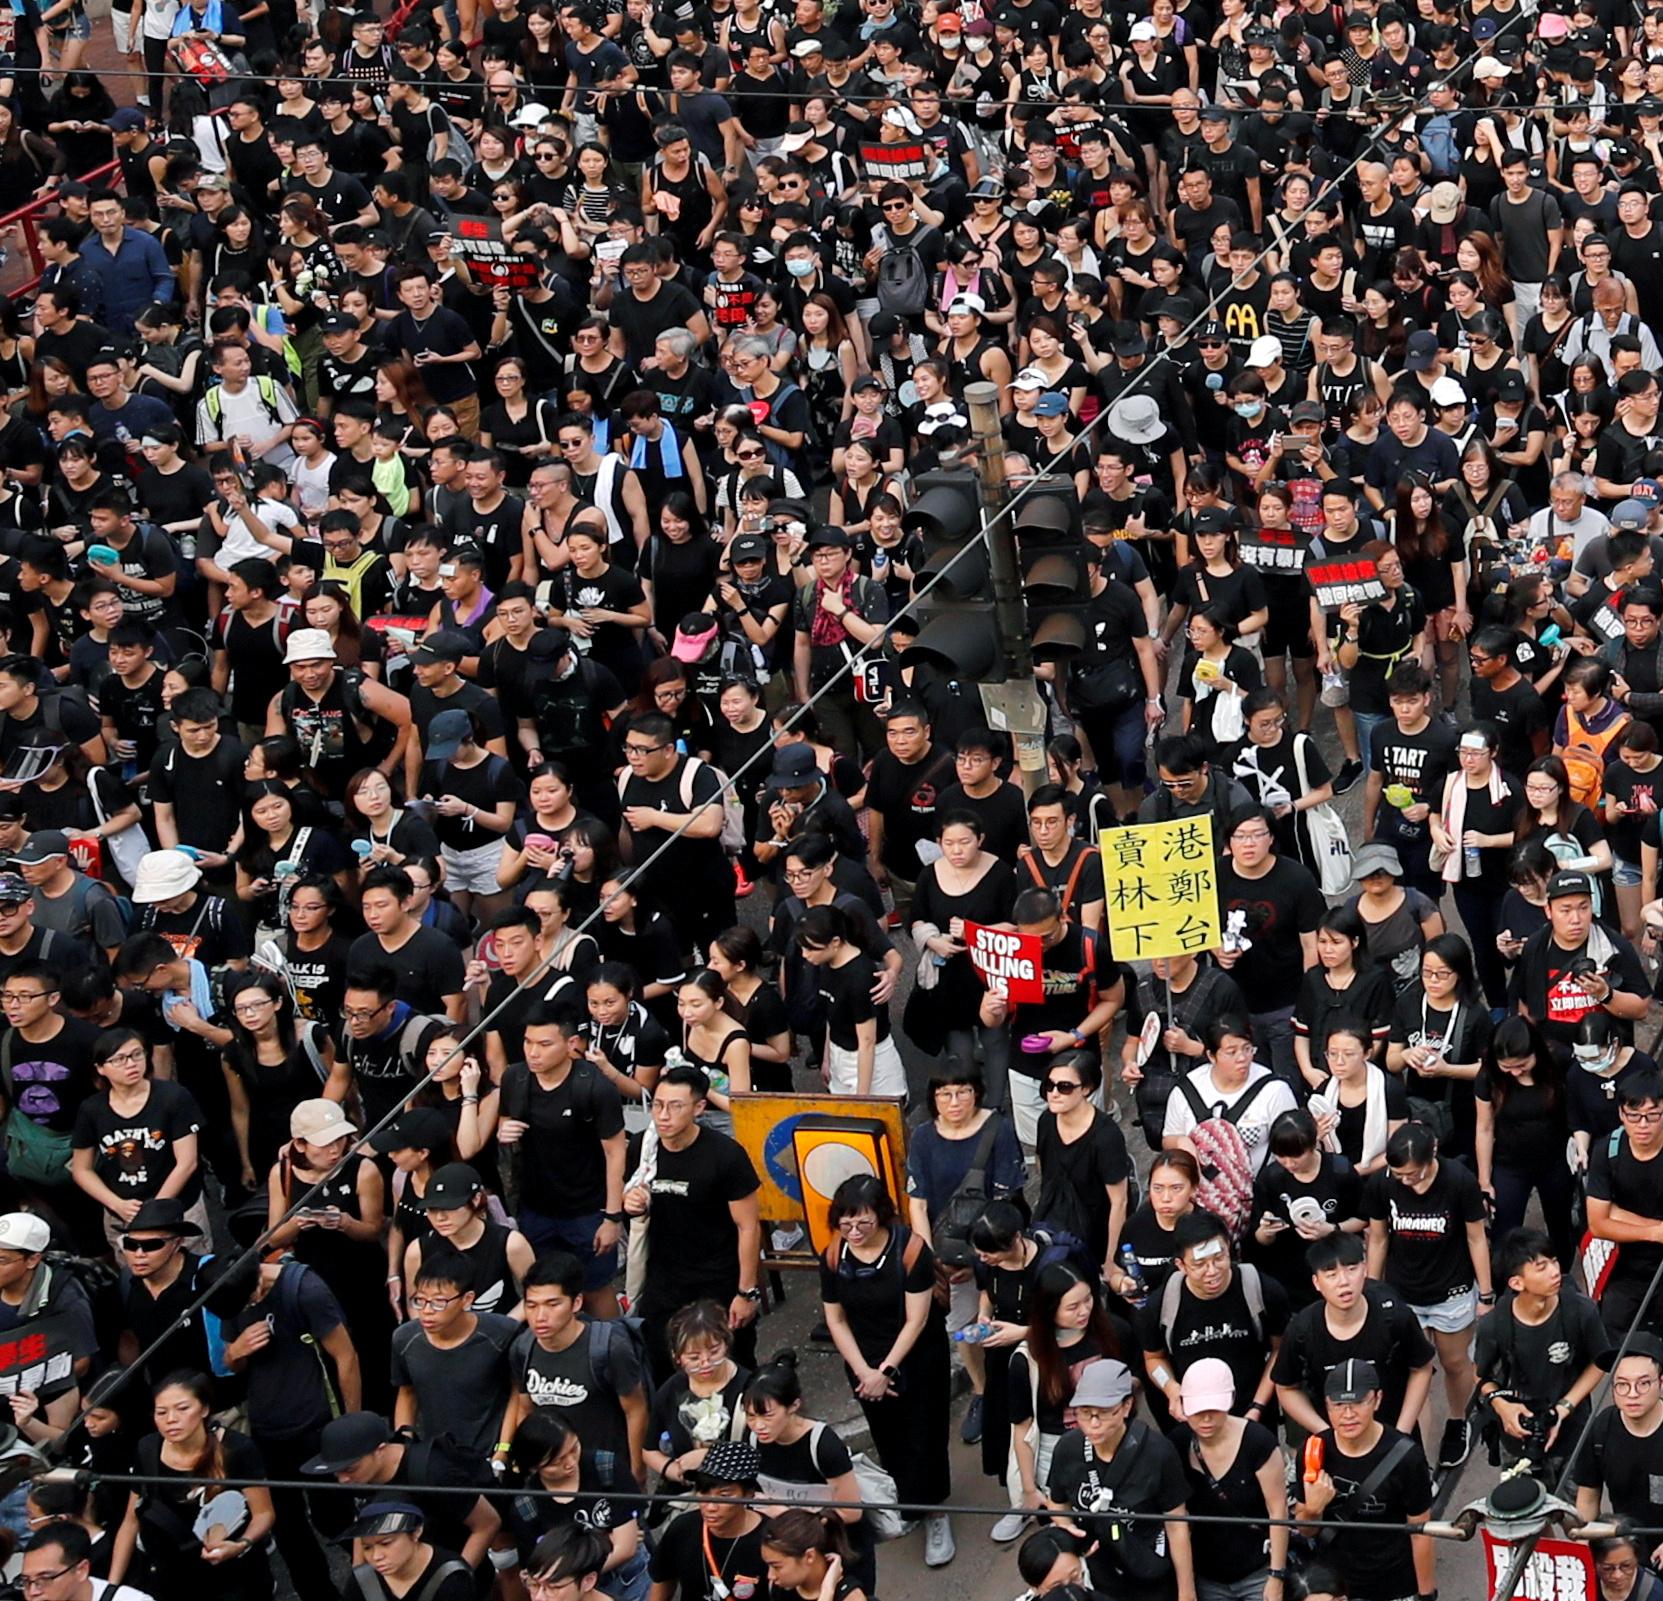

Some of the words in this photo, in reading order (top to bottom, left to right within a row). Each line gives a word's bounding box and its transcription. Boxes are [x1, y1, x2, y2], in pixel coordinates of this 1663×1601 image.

[1112, 824, 1210, 870] 賣港
[1109, 870, 1215, 914] 林鄭
[975, 929, 1021, 956] STOP
[1114, 913, 1211, 956] 下台
[311, 963, 327, 975] IS
[970, 945, 1035, 981] KILLING
[985, 975, 1009, 1001] US
[118, 1169, 148, 1187] APE
[1389, 1198, 1447, 1235] THRASHER
[527, 1368, 589, 1399] Dickies
